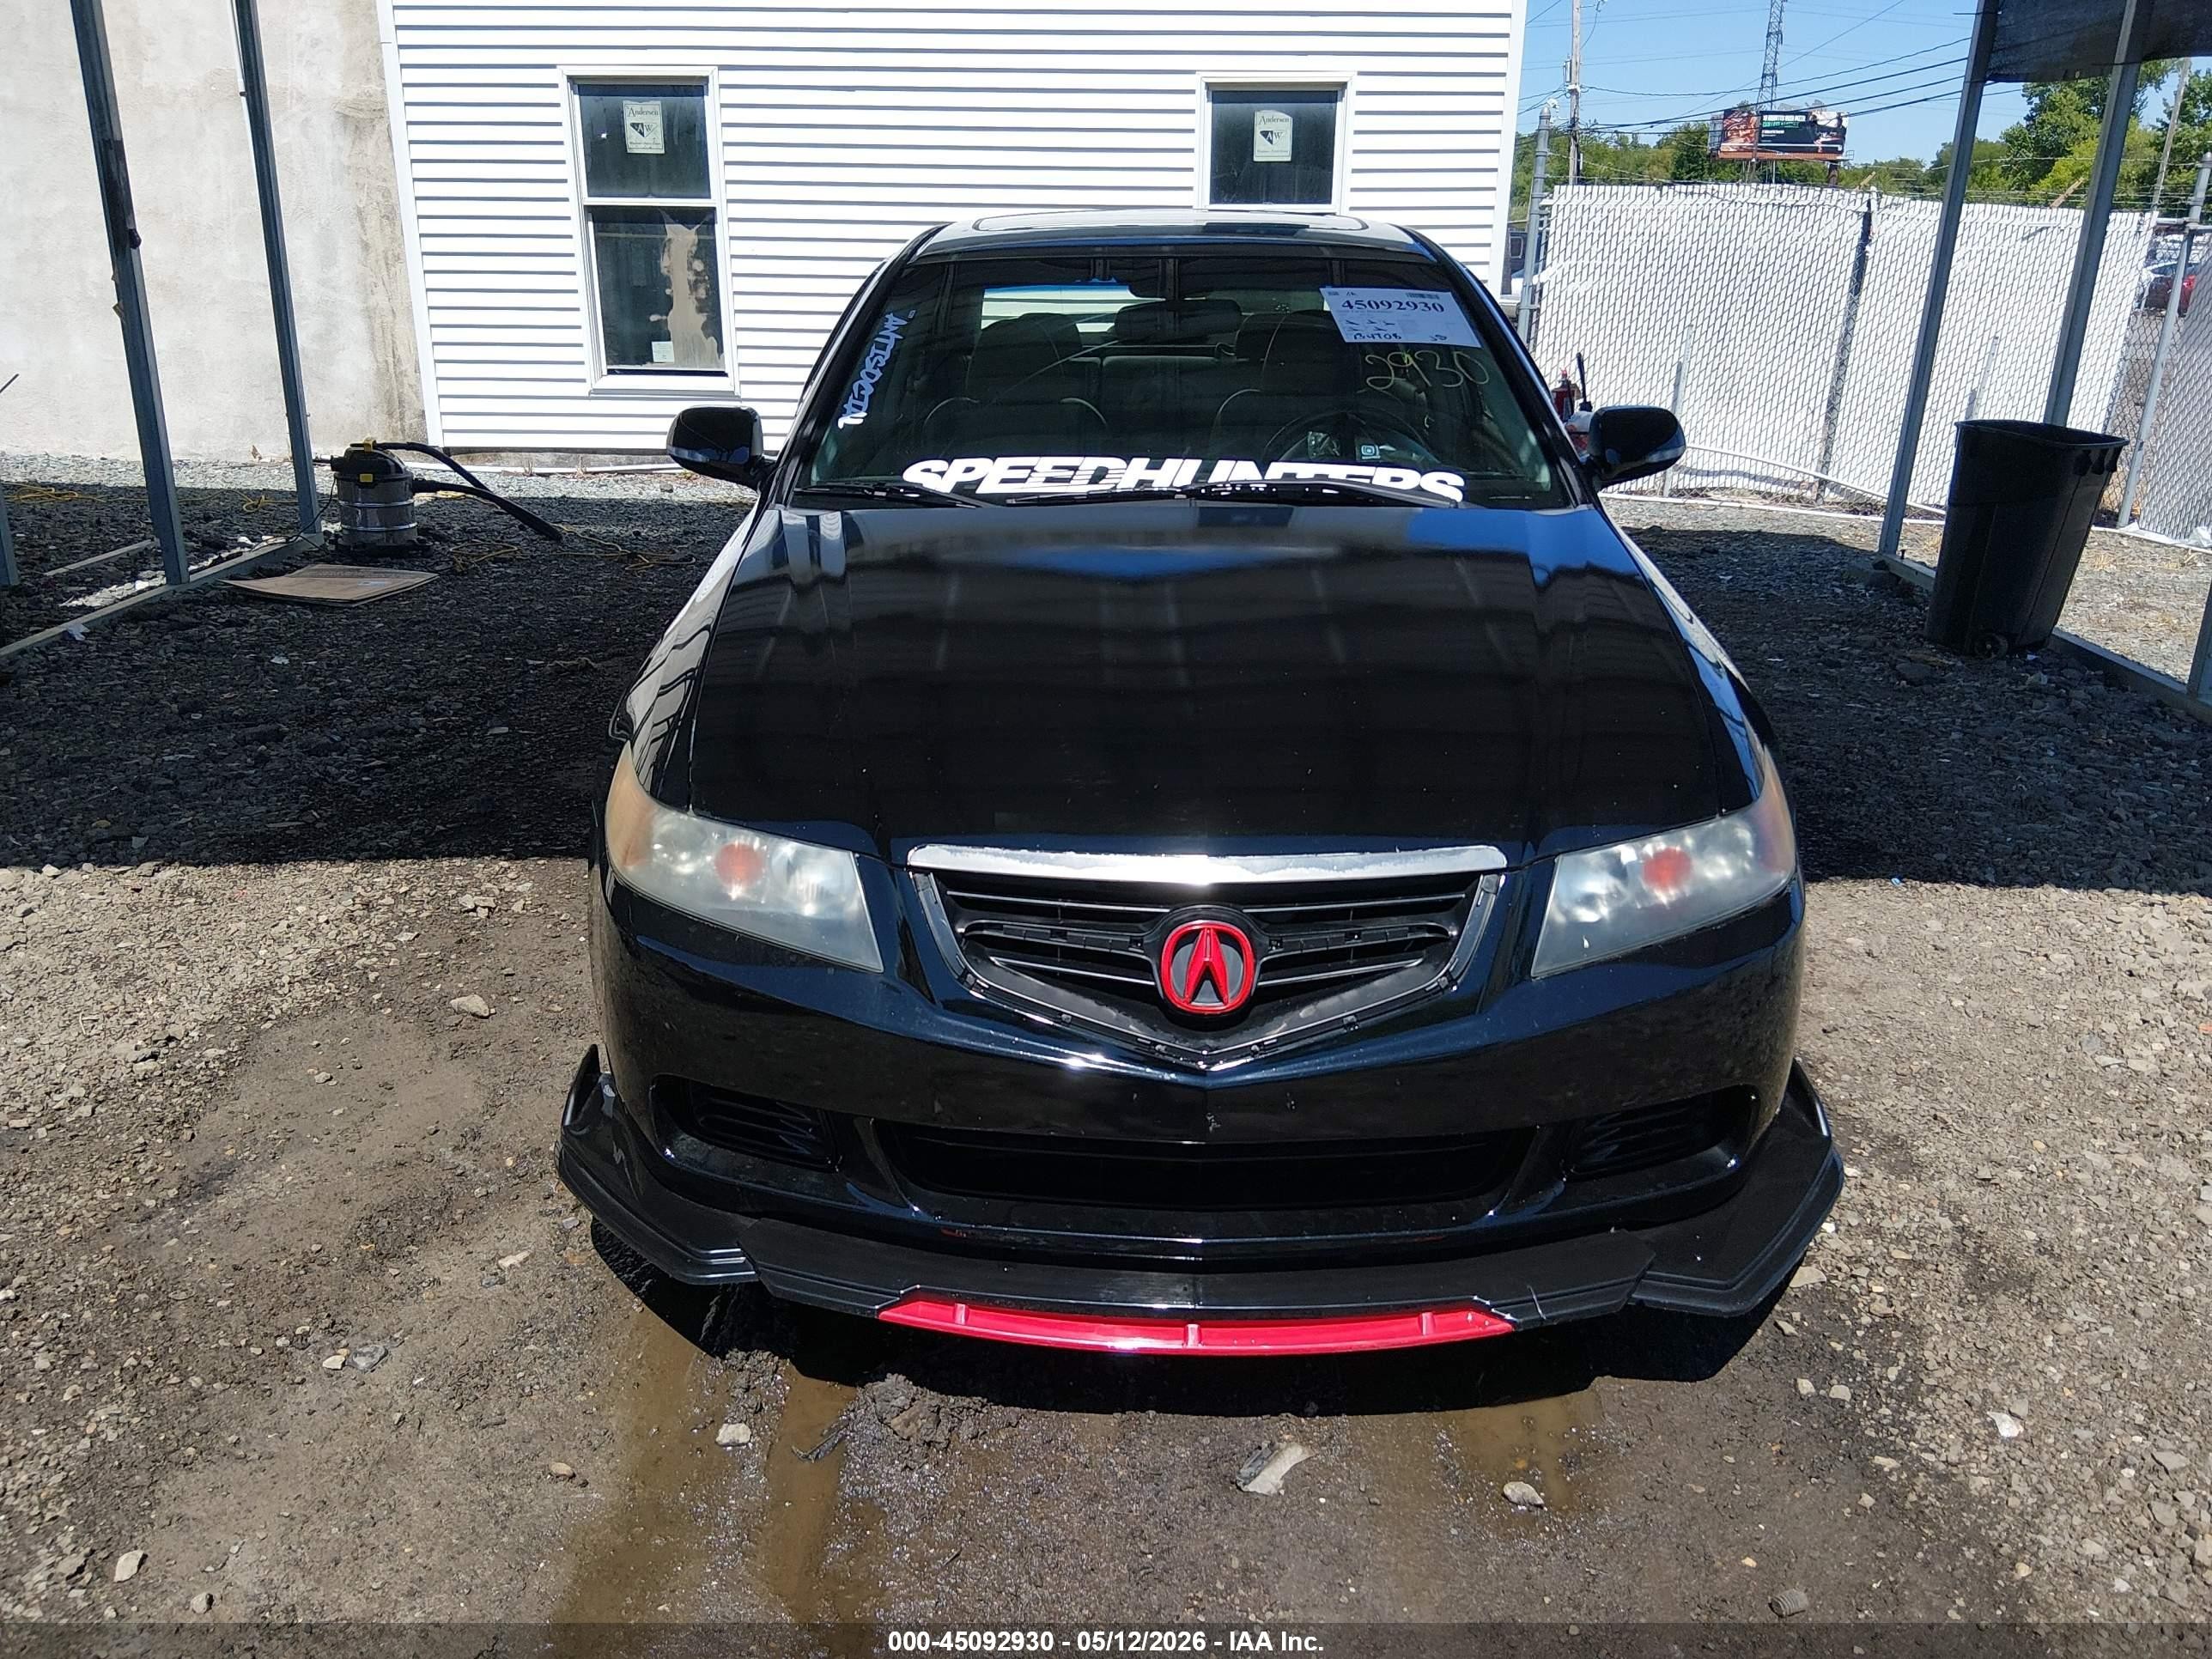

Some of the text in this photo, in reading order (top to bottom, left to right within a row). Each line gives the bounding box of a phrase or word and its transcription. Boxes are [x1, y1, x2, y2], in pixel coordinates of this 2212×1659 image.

[627, 106, 659, 117] Andersen
[1258, 115, 1289, 125] Andersen
[1341, 300, 1444, 313] 45092930
[1364, 350, 1489, 390] 2930
